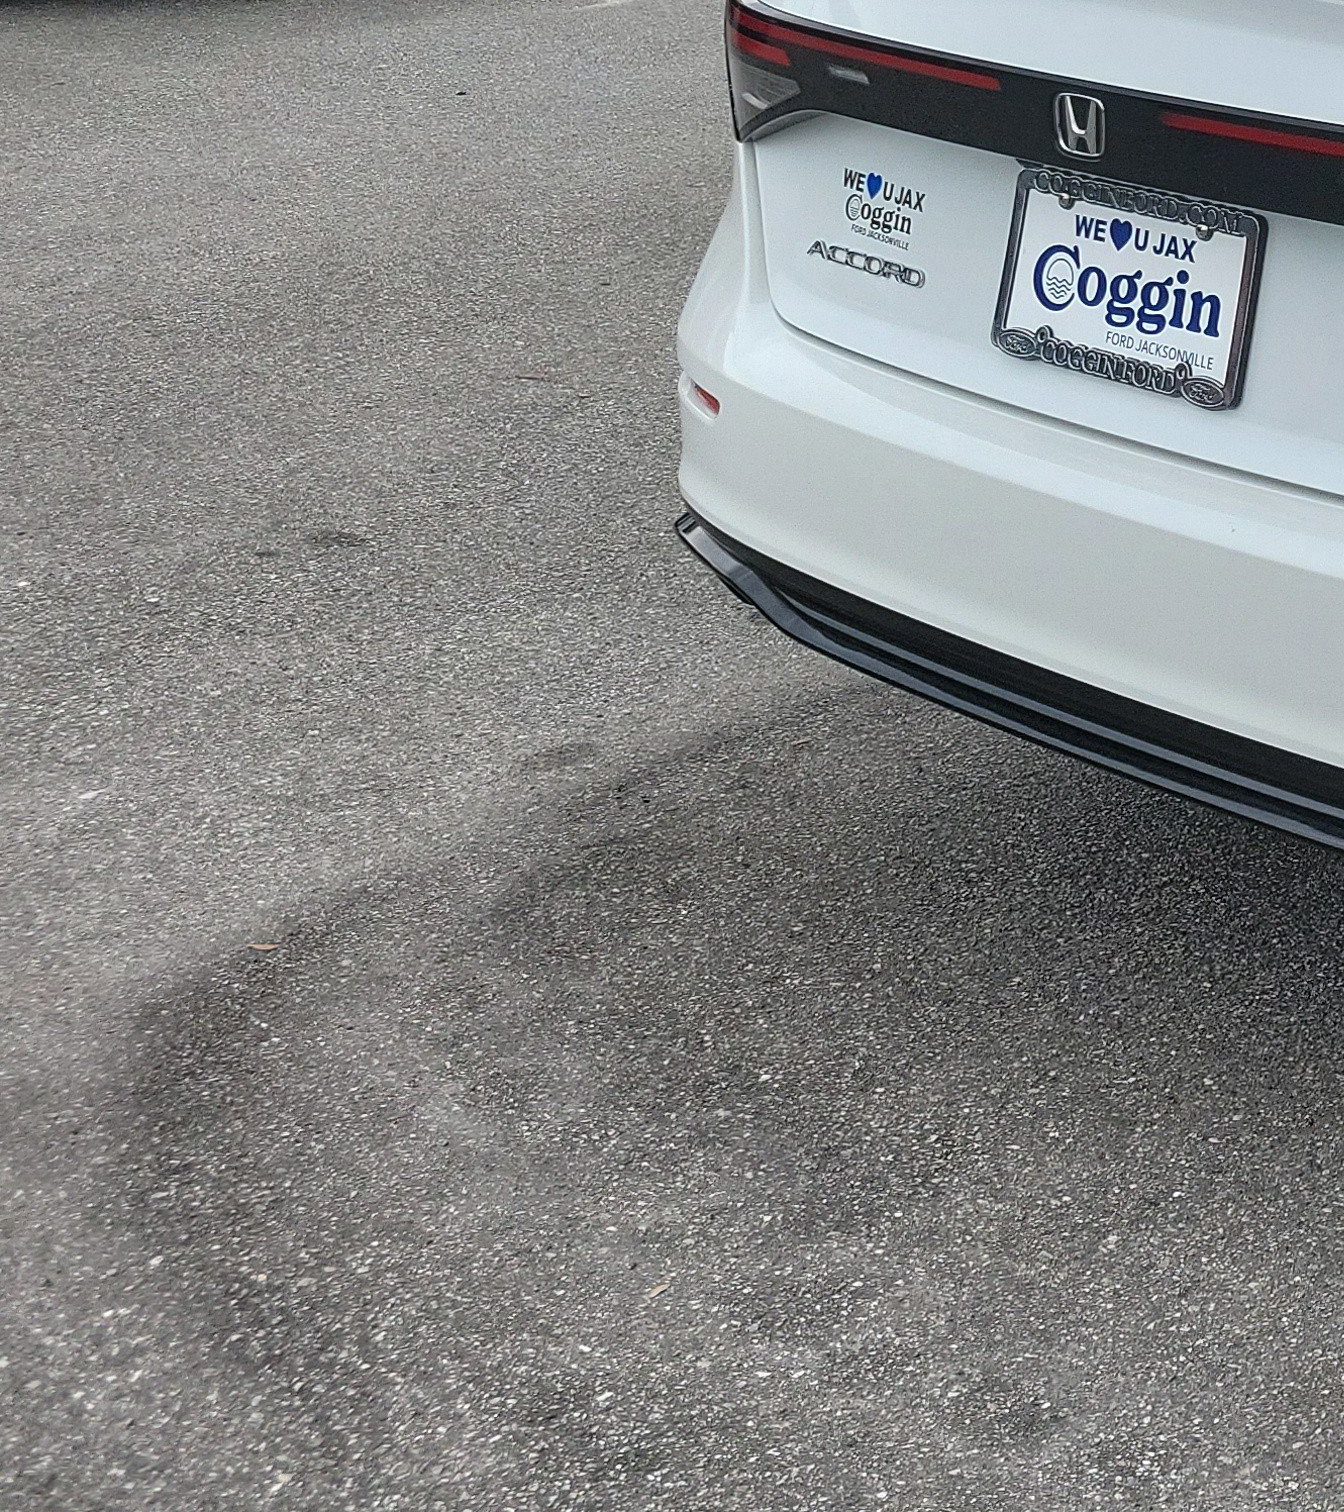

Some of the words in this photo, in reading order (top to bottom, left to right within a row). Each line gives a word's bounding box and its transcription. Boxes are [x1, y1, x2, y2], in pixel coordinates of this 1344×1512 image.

[844, 168, 866, 192] WE
[883, 181, 894, 201] U
[895, 187, 925, 212] JAX
[1034, 172, 1242, 234] COGGINFORD.COM
[845, 194, 911, 235] Coggin
[851, 224, 867, 236] FORD
[867, 229, 910, 251] JACKSONVILLE
[1075, 214, 1107, 243] WE
[1134, 228, 1149, 251] U
[1153, 233, 1197, 263] JAX
[807, 240, 925, 288] ACCORD
[1033, 244, 1221, 338] Coggin
[1040, 338, 1121, 380] COGGIN
[1122, 360, 1176, 394] FORD
[1106, 331, 1134, 349] FORD
[1135, 338, 1214, 371] JACKSONVILLE
